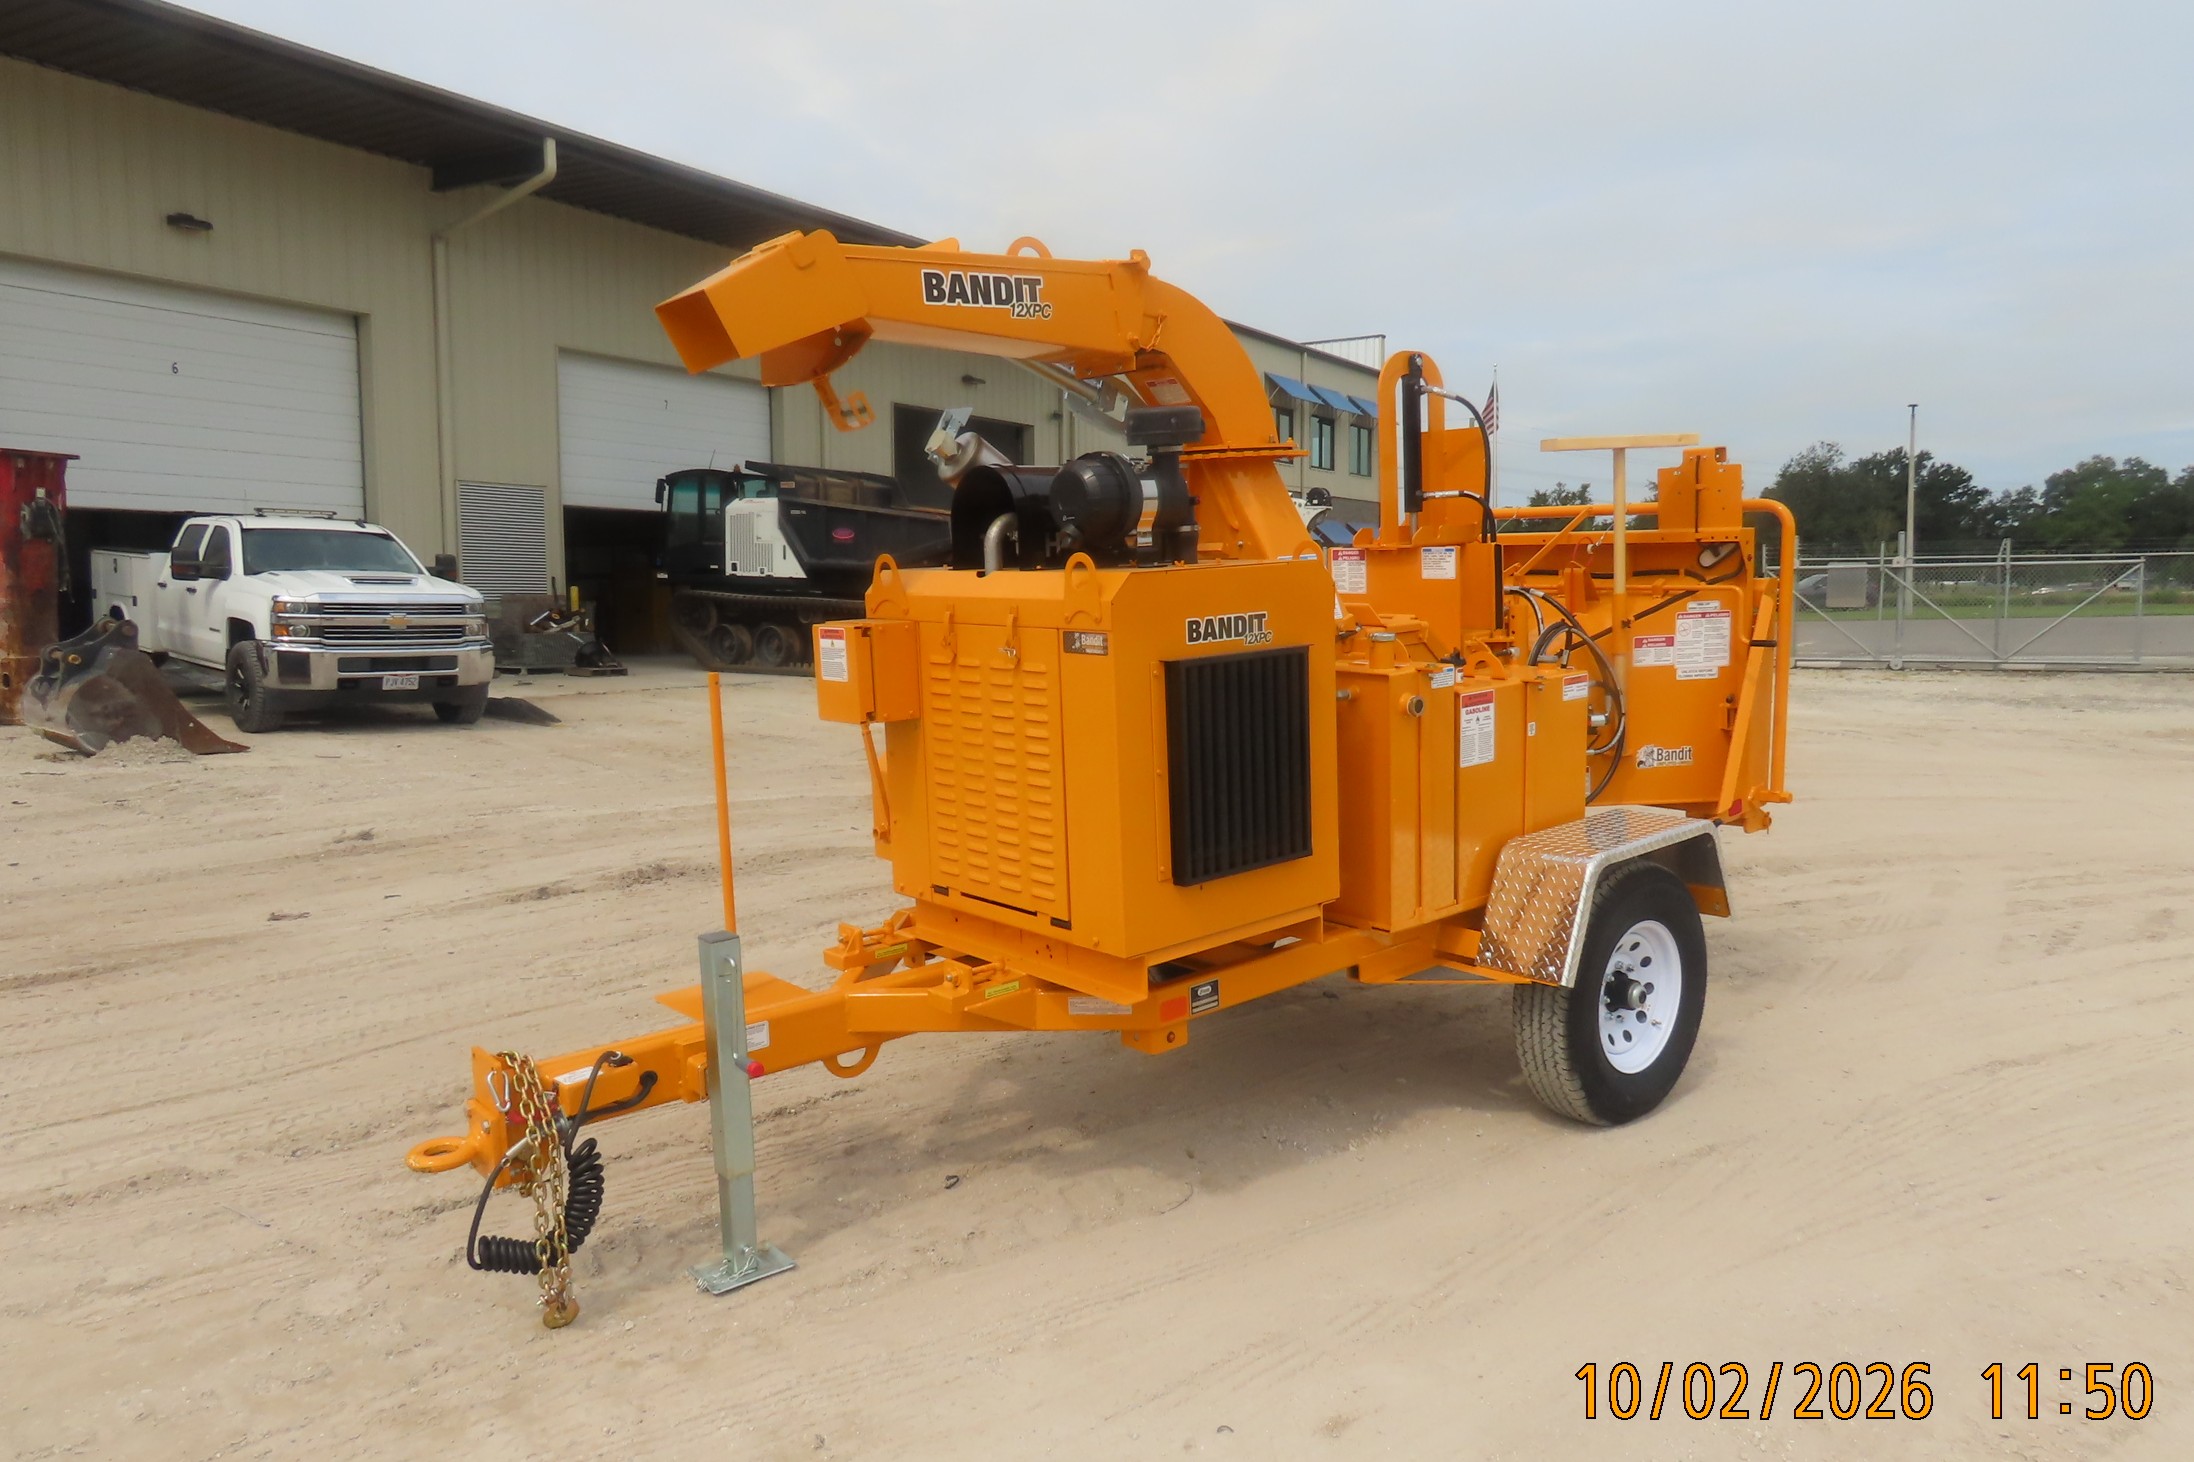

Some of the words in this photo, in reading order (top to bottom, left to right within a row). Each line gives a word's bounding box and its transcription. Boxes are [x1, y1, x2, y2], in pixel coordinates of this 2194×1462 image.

[922, 270, 1042, 307] BANDIT
[1009, 302, 1052, 319] 12XPC
[172, 361, 179, 375] 6
[1187, 612, 1267, 643] BANDIT
[1081, 633, 1104, 647] Bandit
[1243, 631, 1273, 646] 12XPC
[1465, 705, 1491, 716] GASOLINE
[1656, 747, 1692, 762] Bandit
